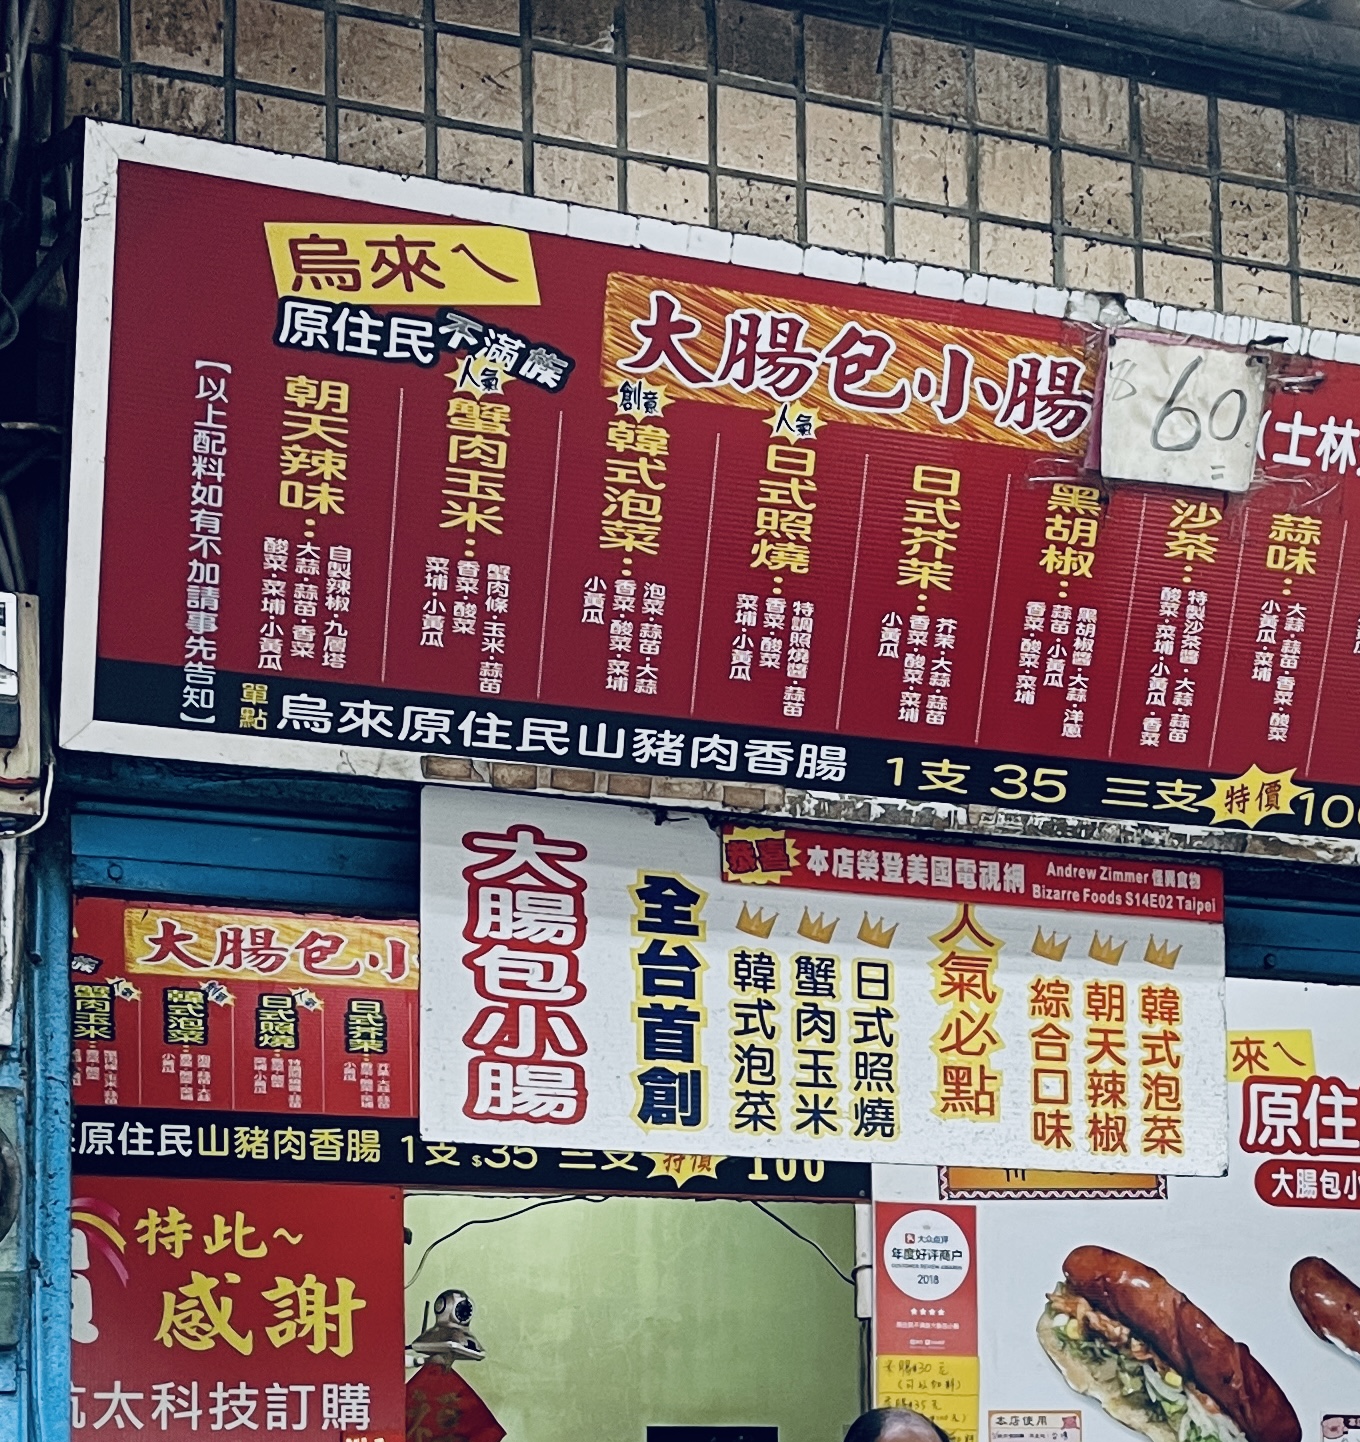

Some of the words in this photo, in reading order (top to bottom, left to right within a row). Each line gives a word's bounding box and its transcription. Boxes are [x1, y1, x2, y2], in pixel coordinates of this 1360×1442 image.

[619, 291, 1092, 442] 大腸包小腸
[239, 684, 268, 731] 單點
[277, 694, 847, 781] 烏來原住民山豬肉香腸
[888, 757, 969, 794] 1支
[991, 766, 1068, 802] 35
[1101, 776, 1202, 811] 三支
[1224, 783, 1283, 813] 特價
[725, 836, 791, 875] 恭喜
[806, 845, 1025, 895] 本店榮登美國電視網
[1032, 884, 1081, 903] Bizarre
[1083, 888, 1123, 906] Foods
[1125, 890, 1174, 909] S14E02
[1176, 895, 1216, 916] Taipei
[1046, 861, 1096, 881] Andrew
[1099, 866, 1149, 885] Zimmer
[465, 828, 586, 1121] 大腸包小腸
[636, 873, 703, 1128] 全台首創
[733, 950, 776, 1133] 韓式泡菜
[794, 955, 838, 1136] 蟹肉玉米
[853, 961, 895, 1138] 日式照燒
[939, 905, 998, 1116] 人氣必點
[72, 1122, 381, 1163] 原住民山豬肉香腸
[1030, 979, 1073, 1151] 綜合口味
[1086, 982, 1127, 1155] 朝天辣椒
[1141, 986, 1184, 1156] 韓式泡菜
[162, 1270, 368, 1357] 感謝
[917, 1275, 939, 1285] 2018
